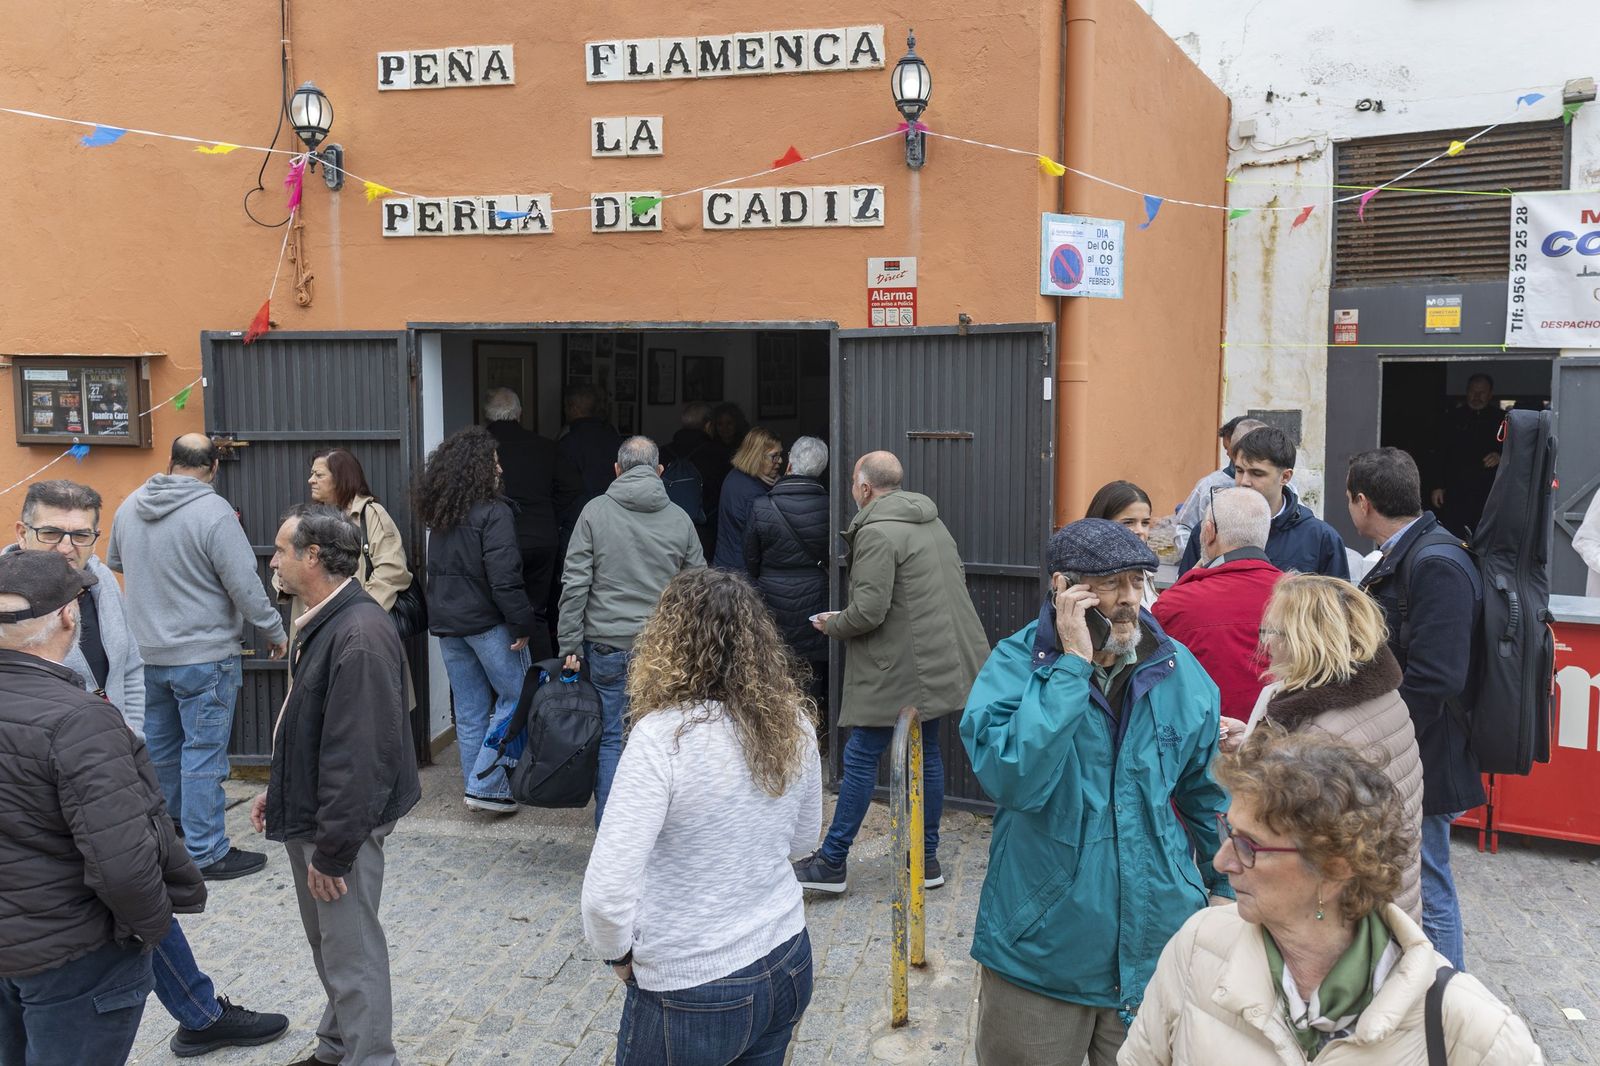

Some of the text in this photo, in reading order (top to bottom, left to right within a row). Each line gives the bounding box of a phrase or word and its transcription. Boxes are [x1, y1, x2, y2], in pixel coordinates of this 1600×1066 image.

[379, 31, 880, 86] PEÑA FLAMENCA
[596, 119, 657, 152] LA
[385, 187, 882, 232] PERLA DE CADIZ
[1516, 206, 1529, 225] 28
[1096, 228, 1109, 239] DIA
[1515, 230, 1528, 249] 25
[1087, 240, 1115, 251] Del 06
[1087, 254, 1113, 265] al 09
[1514, 254, 1527, 271] 25
[1094, 266, 1110, 277] MES
[1088, 277, 1115, 286] FEBRERO
[1513, 276, 1526, 303] 956
[871, 290, 914, 301] Alarma
[1540, 320, 1600, 329] DESPACHO
[90, 387, 100, 395] 27
